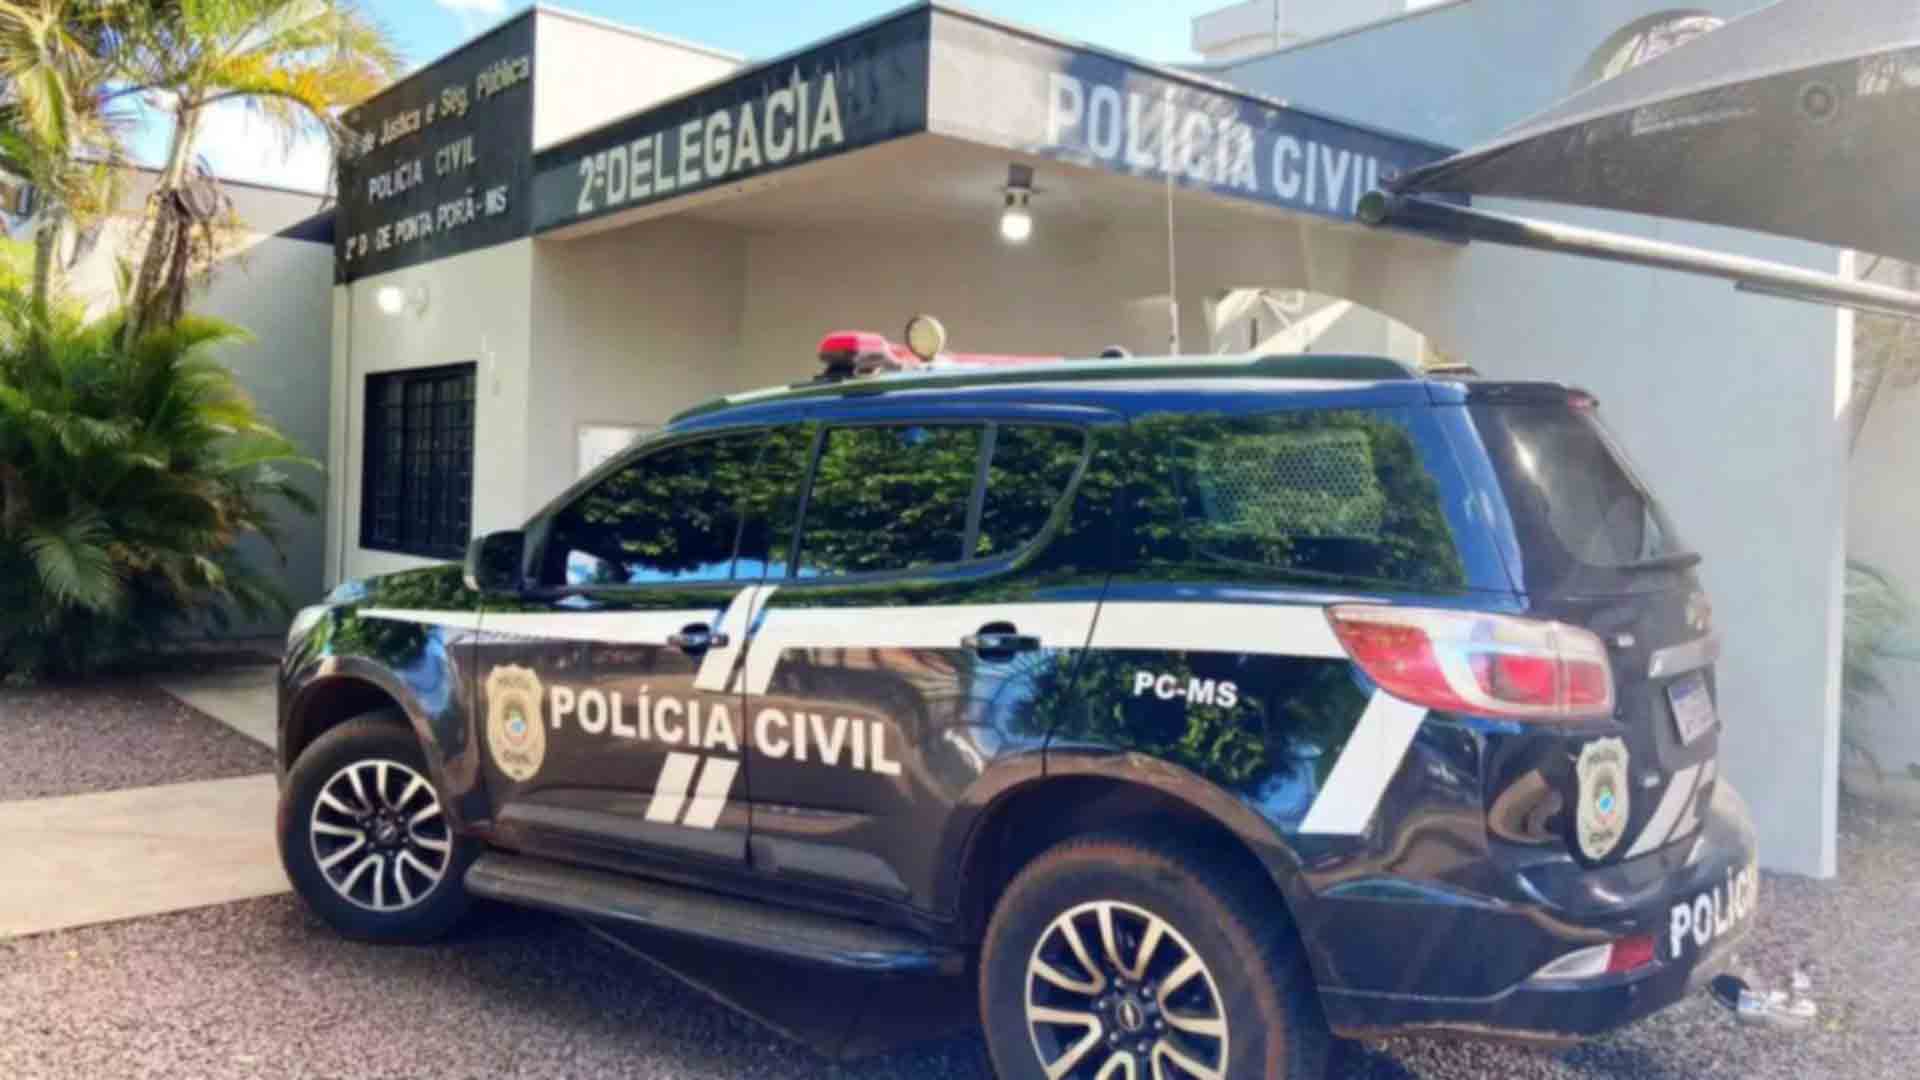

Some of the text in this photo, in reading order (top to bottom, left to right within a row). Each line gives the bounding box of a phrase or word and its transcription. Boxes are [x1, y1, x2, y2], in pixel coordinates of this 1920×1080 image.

[435, 136, 476, 177] CIVIL
[375, 224, 392, 252] DE
[394, 211, 434, 246] PONTA
[1133, 670, 1239, 708] PC-MS
[549, 685, 902, 777] POLÍCIA CIVIL
